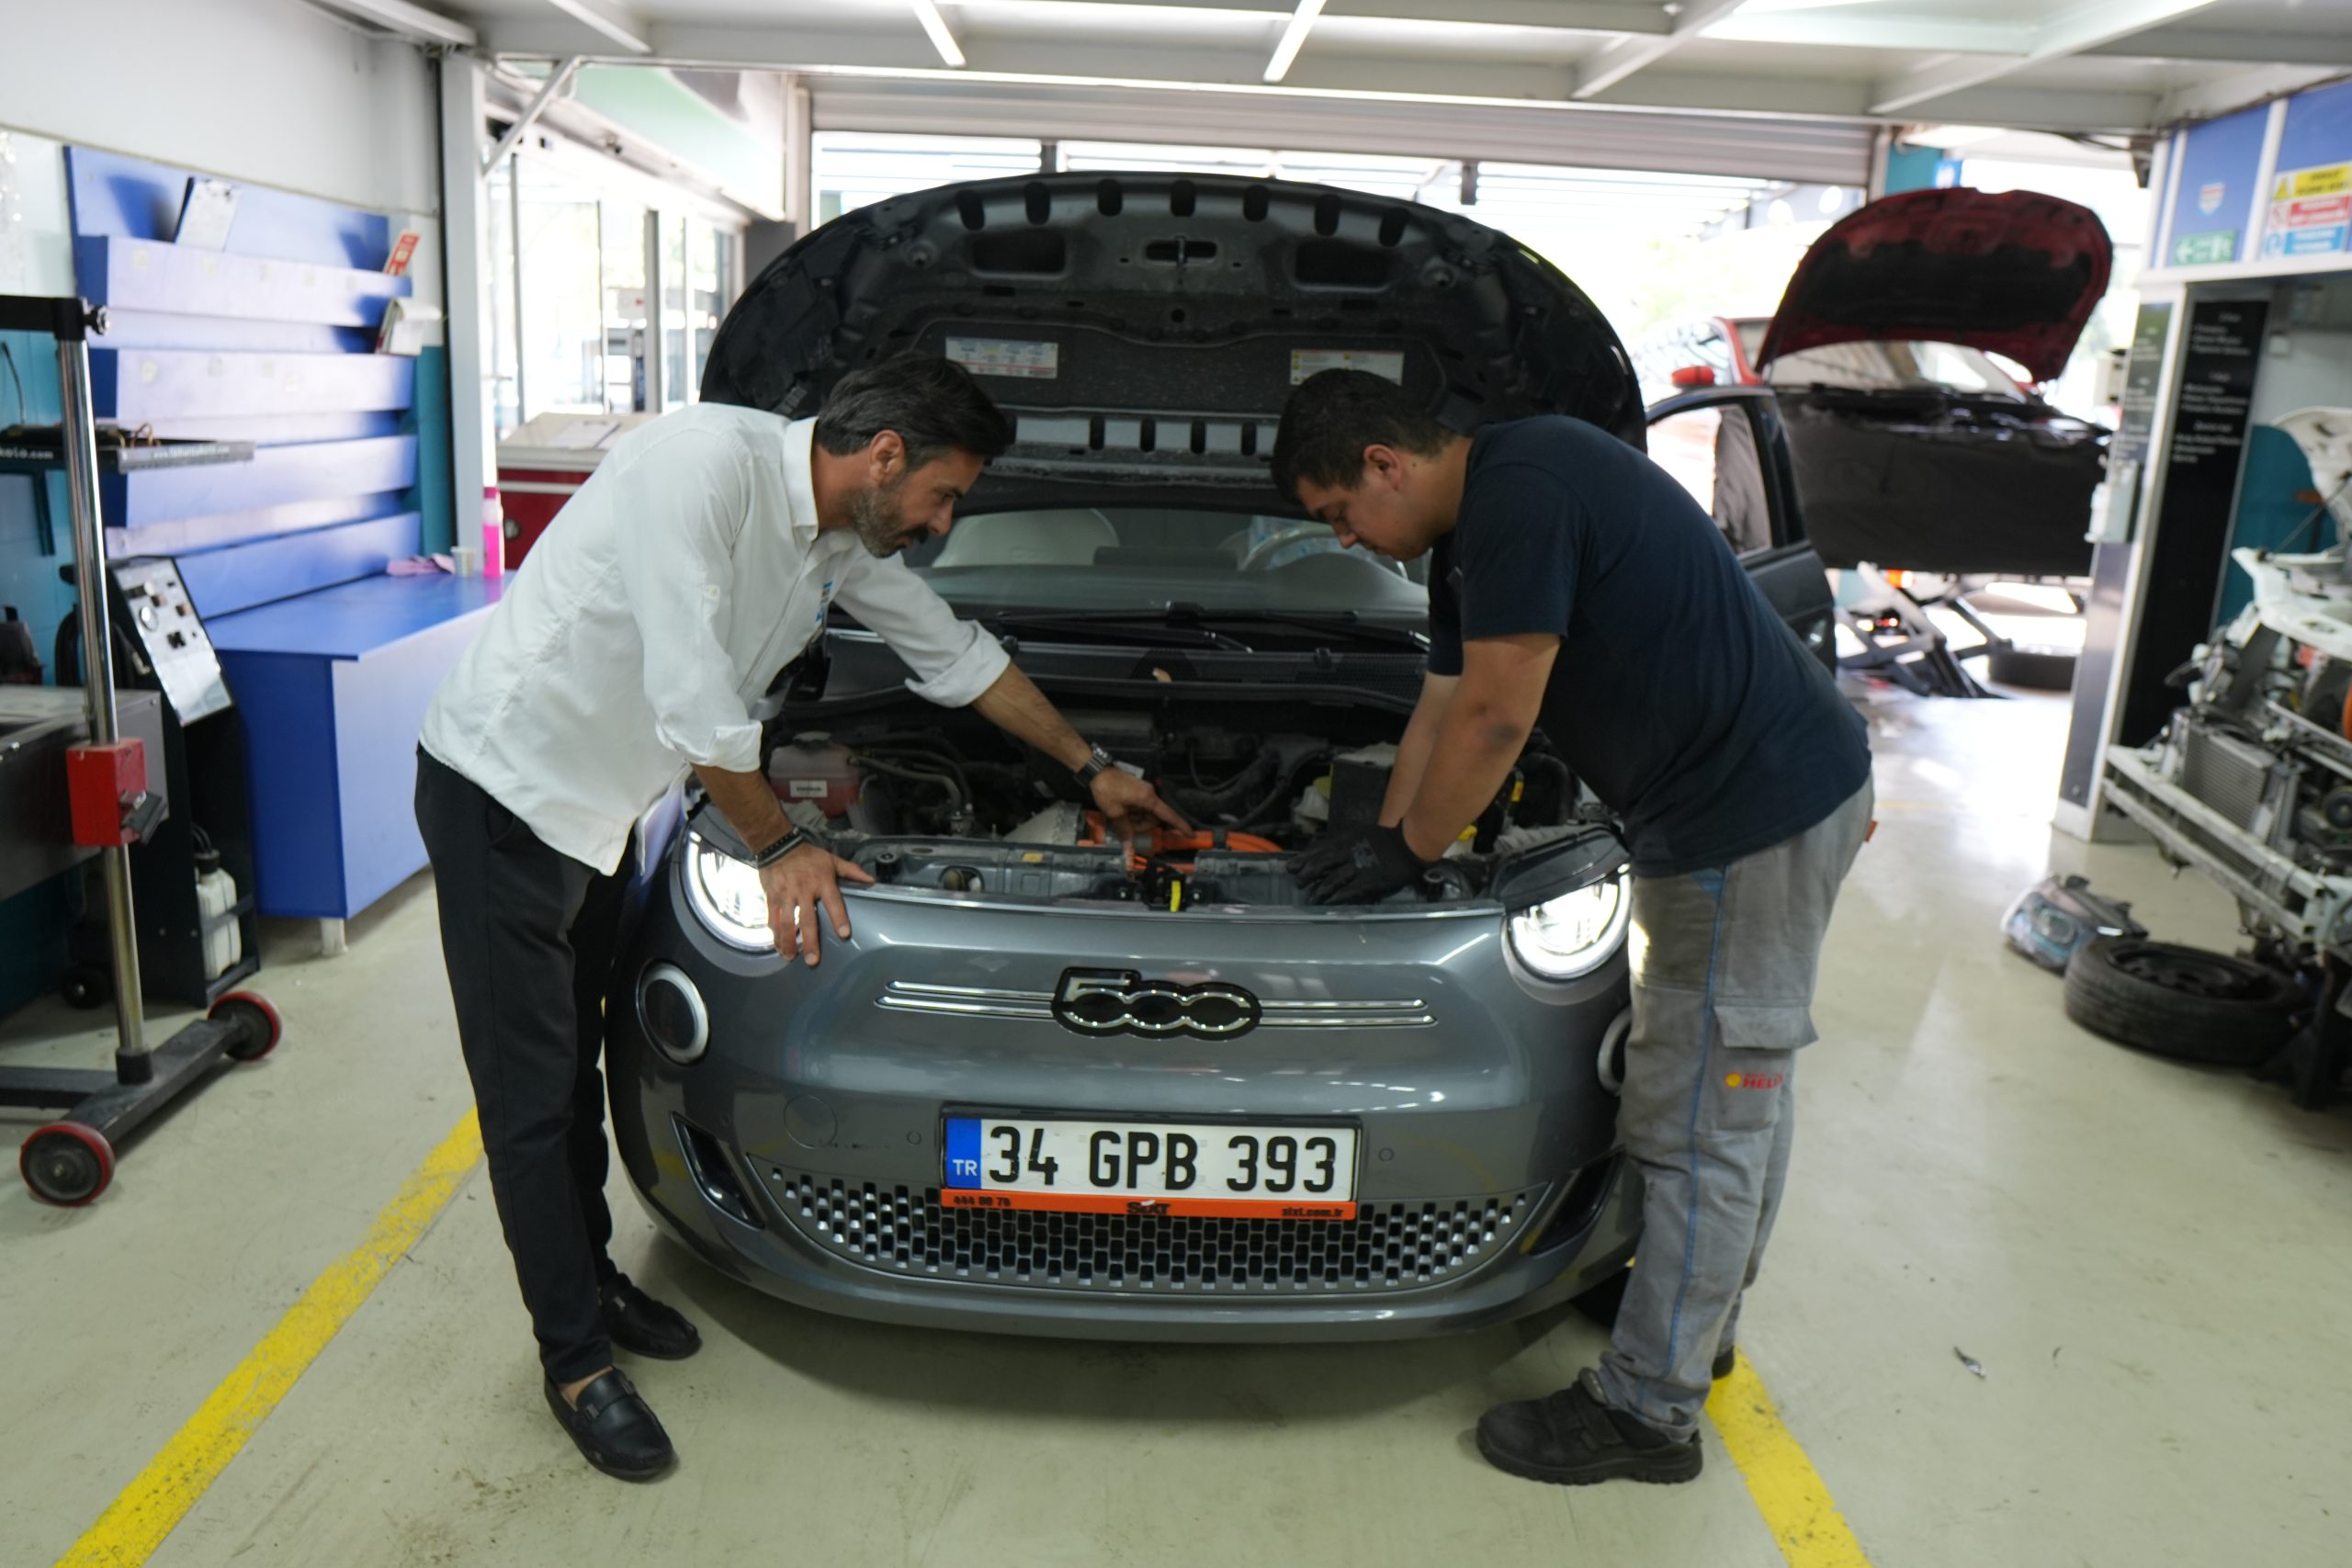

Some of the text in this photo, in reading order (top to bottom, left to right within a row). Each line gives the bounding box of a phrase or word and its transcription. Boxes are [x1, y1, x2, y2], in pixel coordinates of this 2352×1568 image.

[1055, 969, 1261, 1038] 500
[953, 1159, 978, 1177] TR
[989, 1126, 1337, 1193] 34 GPB 393
